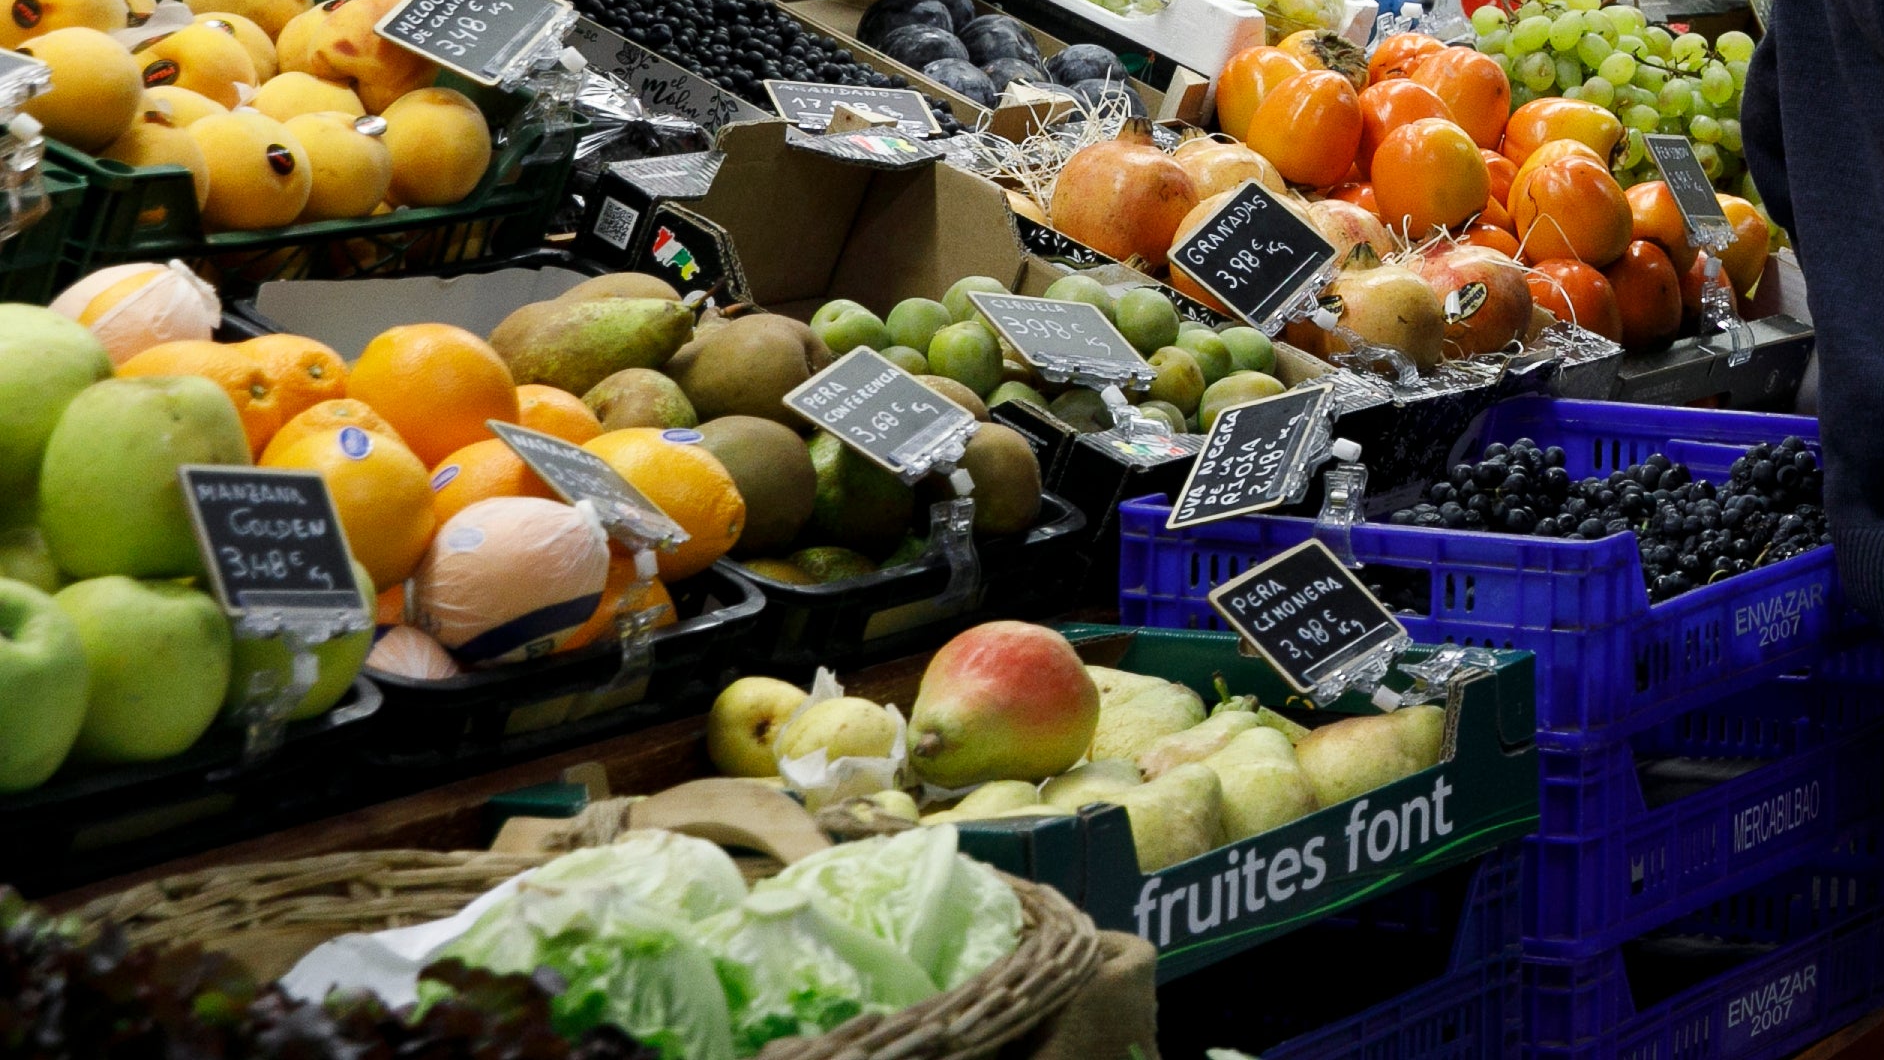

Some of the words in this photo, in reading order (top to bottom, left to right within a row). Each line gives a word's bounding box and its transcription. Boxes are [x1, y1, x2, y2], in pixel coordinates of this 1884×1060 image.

[411, 28, 433, 45] DE
[1187, 194, 1268, 265] GRANADAS
[990, 299, 1067, 314] CIRUELA
[803, 381, 848, 411] PERA
[824, 368, 902, 423] CONFERENCIA
[1178, 484, 1207, 520] UVA
[1198, 409, 1242, 476] NEGRA
[196, 483, 308, 505] MANZANA
[1204, 483, 1225, 506] DE
[1231, 579, 1287, 616] PERA
[1254, 576, 1344, 633] LIMONERA
[1735, 582, 1824, 637] ENVAZAR
[1759, 615, 1801, 647] 2007
[1344, 774, 1454, 874] font
[1733, 779, 1821, 854] MERCABILBAO
[1133, 836, 1328, 948] fruites
[1727, 963, 1818, 1029] ENVAZAR
[1750, 998, 1794, 1038] 2007
